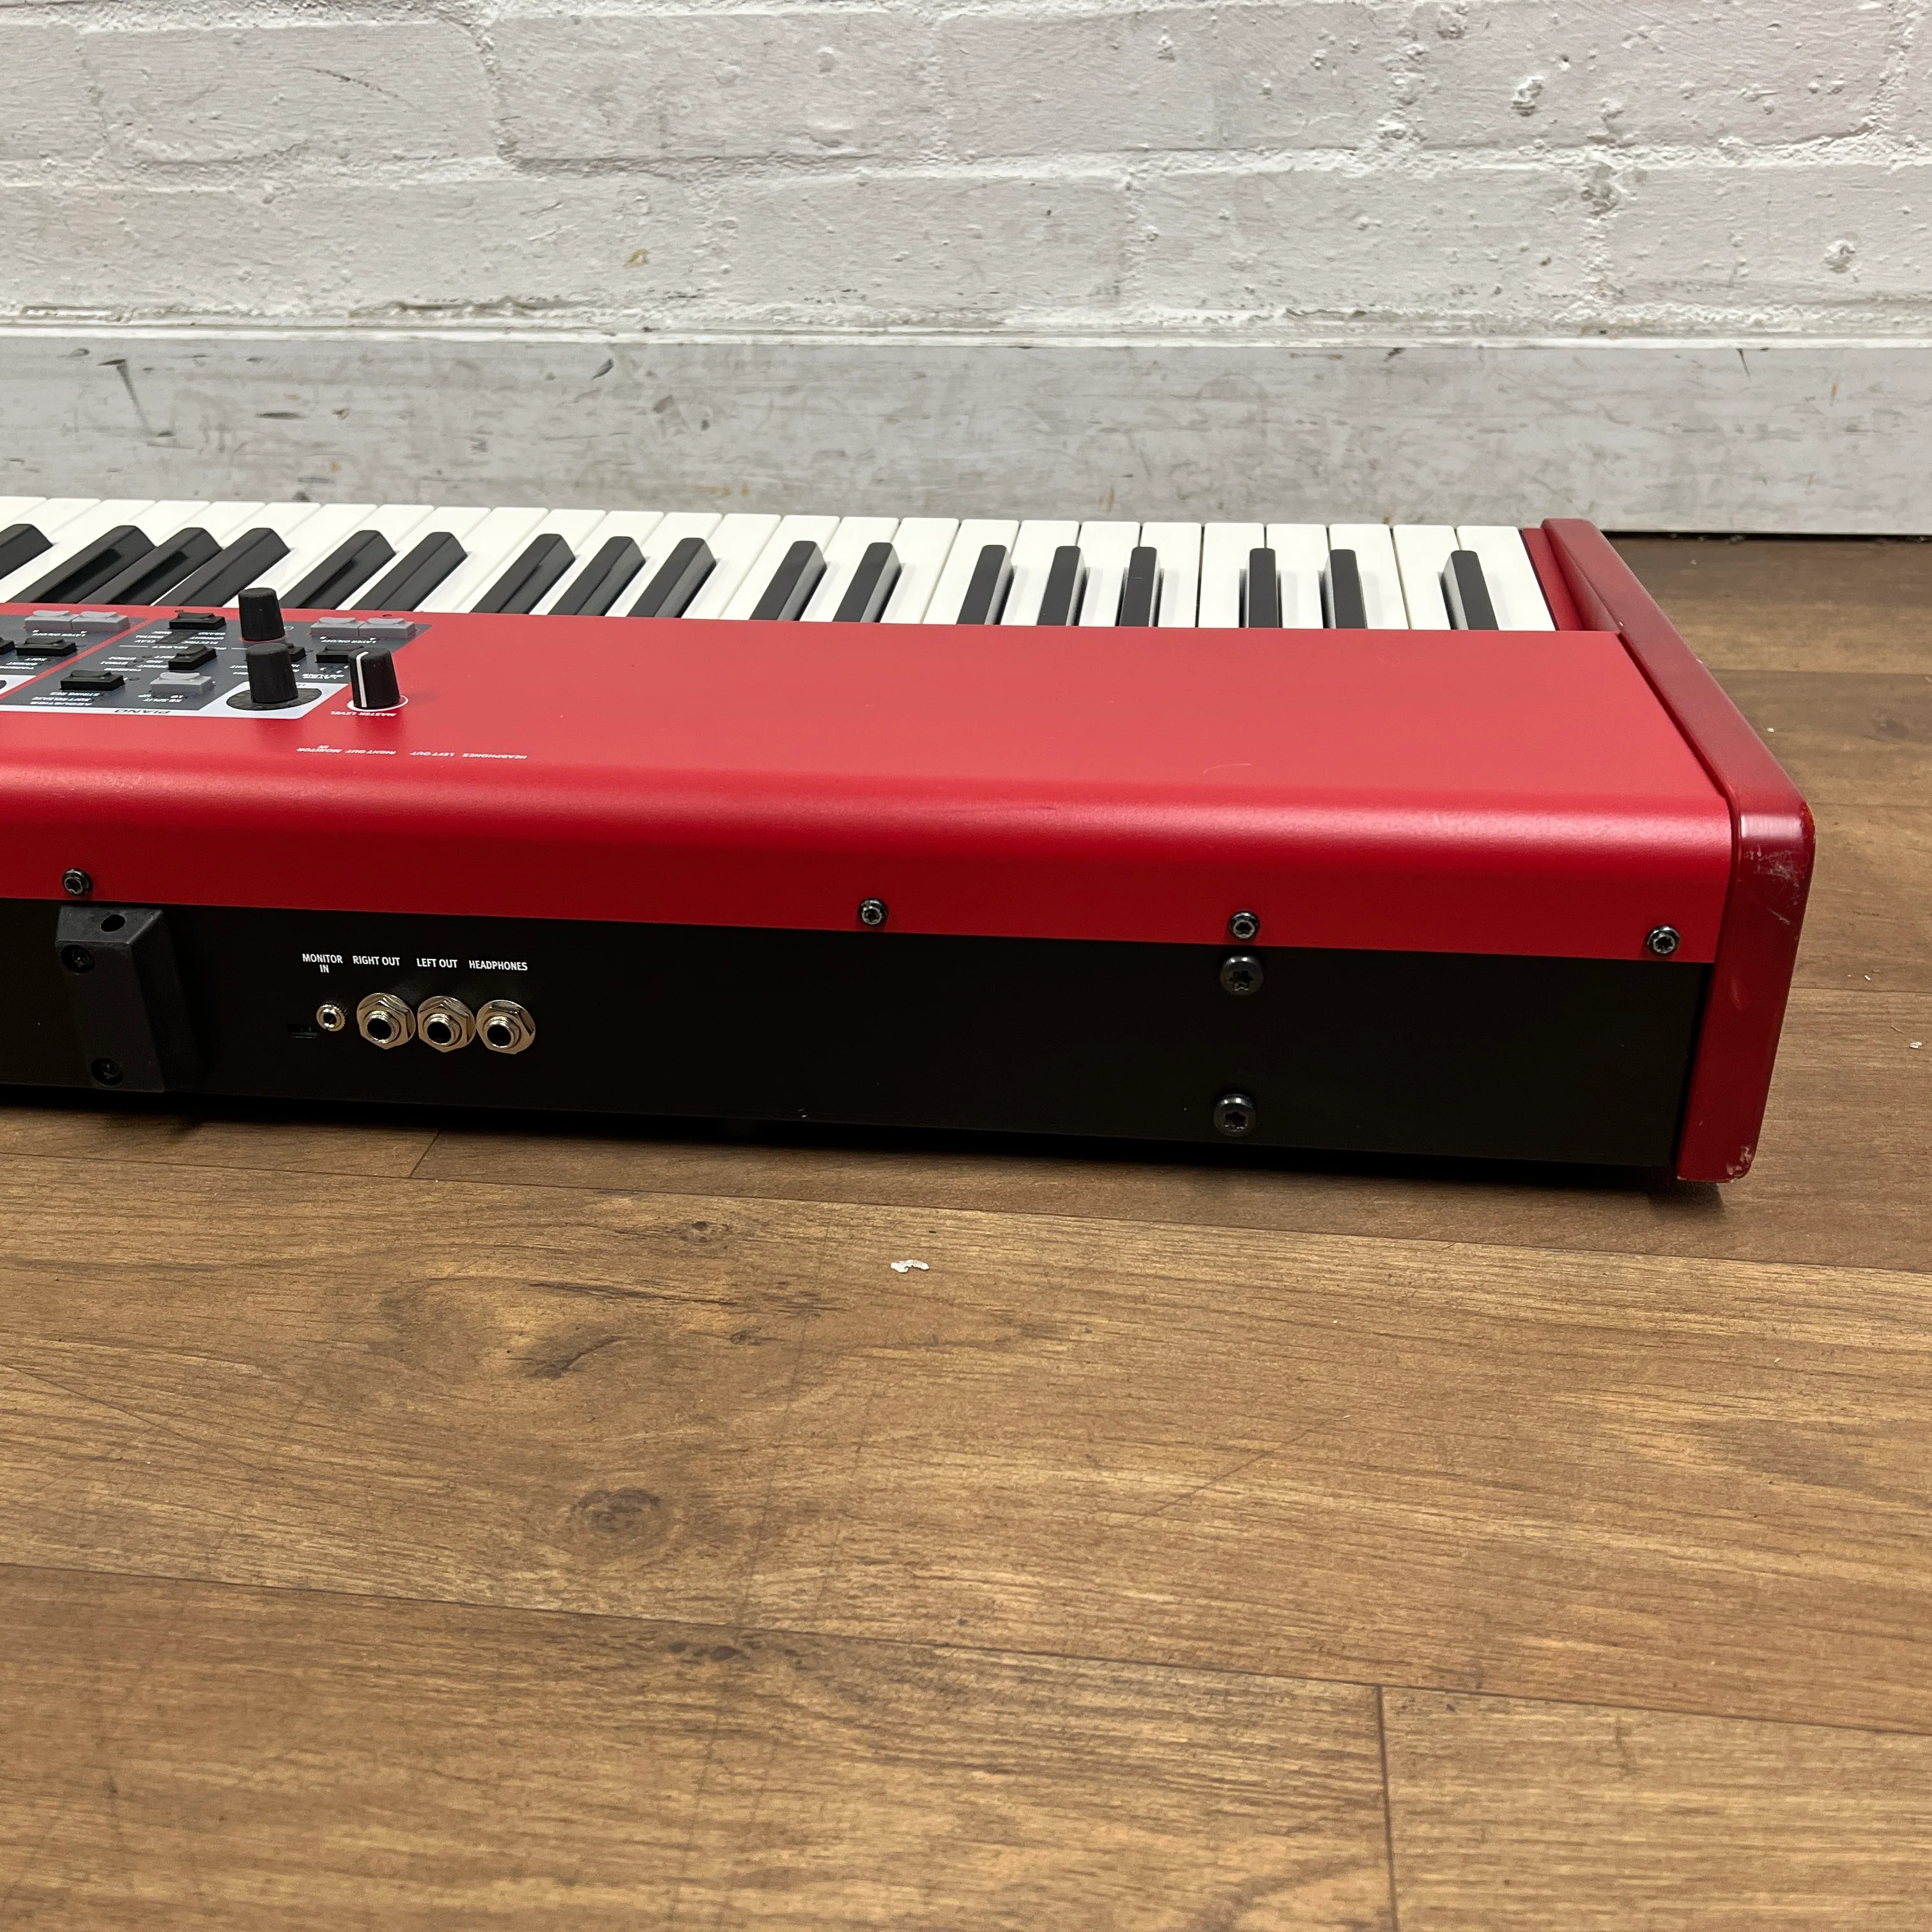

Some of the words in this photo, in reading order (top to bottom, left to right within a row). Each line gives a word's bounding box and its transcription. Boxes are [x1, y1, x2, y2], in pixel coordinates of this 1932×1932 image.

[302, 953, 344, 964] MONITOR
[352, 955, 379, 966] RIGHT
[381, 956, 401, 967] OUT
[416, 958, 437, 968] LEFT
[438, 959, 458, 969] OUT
[319, 964, 330, 974] IN
[468, 960, 528, 971] HEADPHONES
